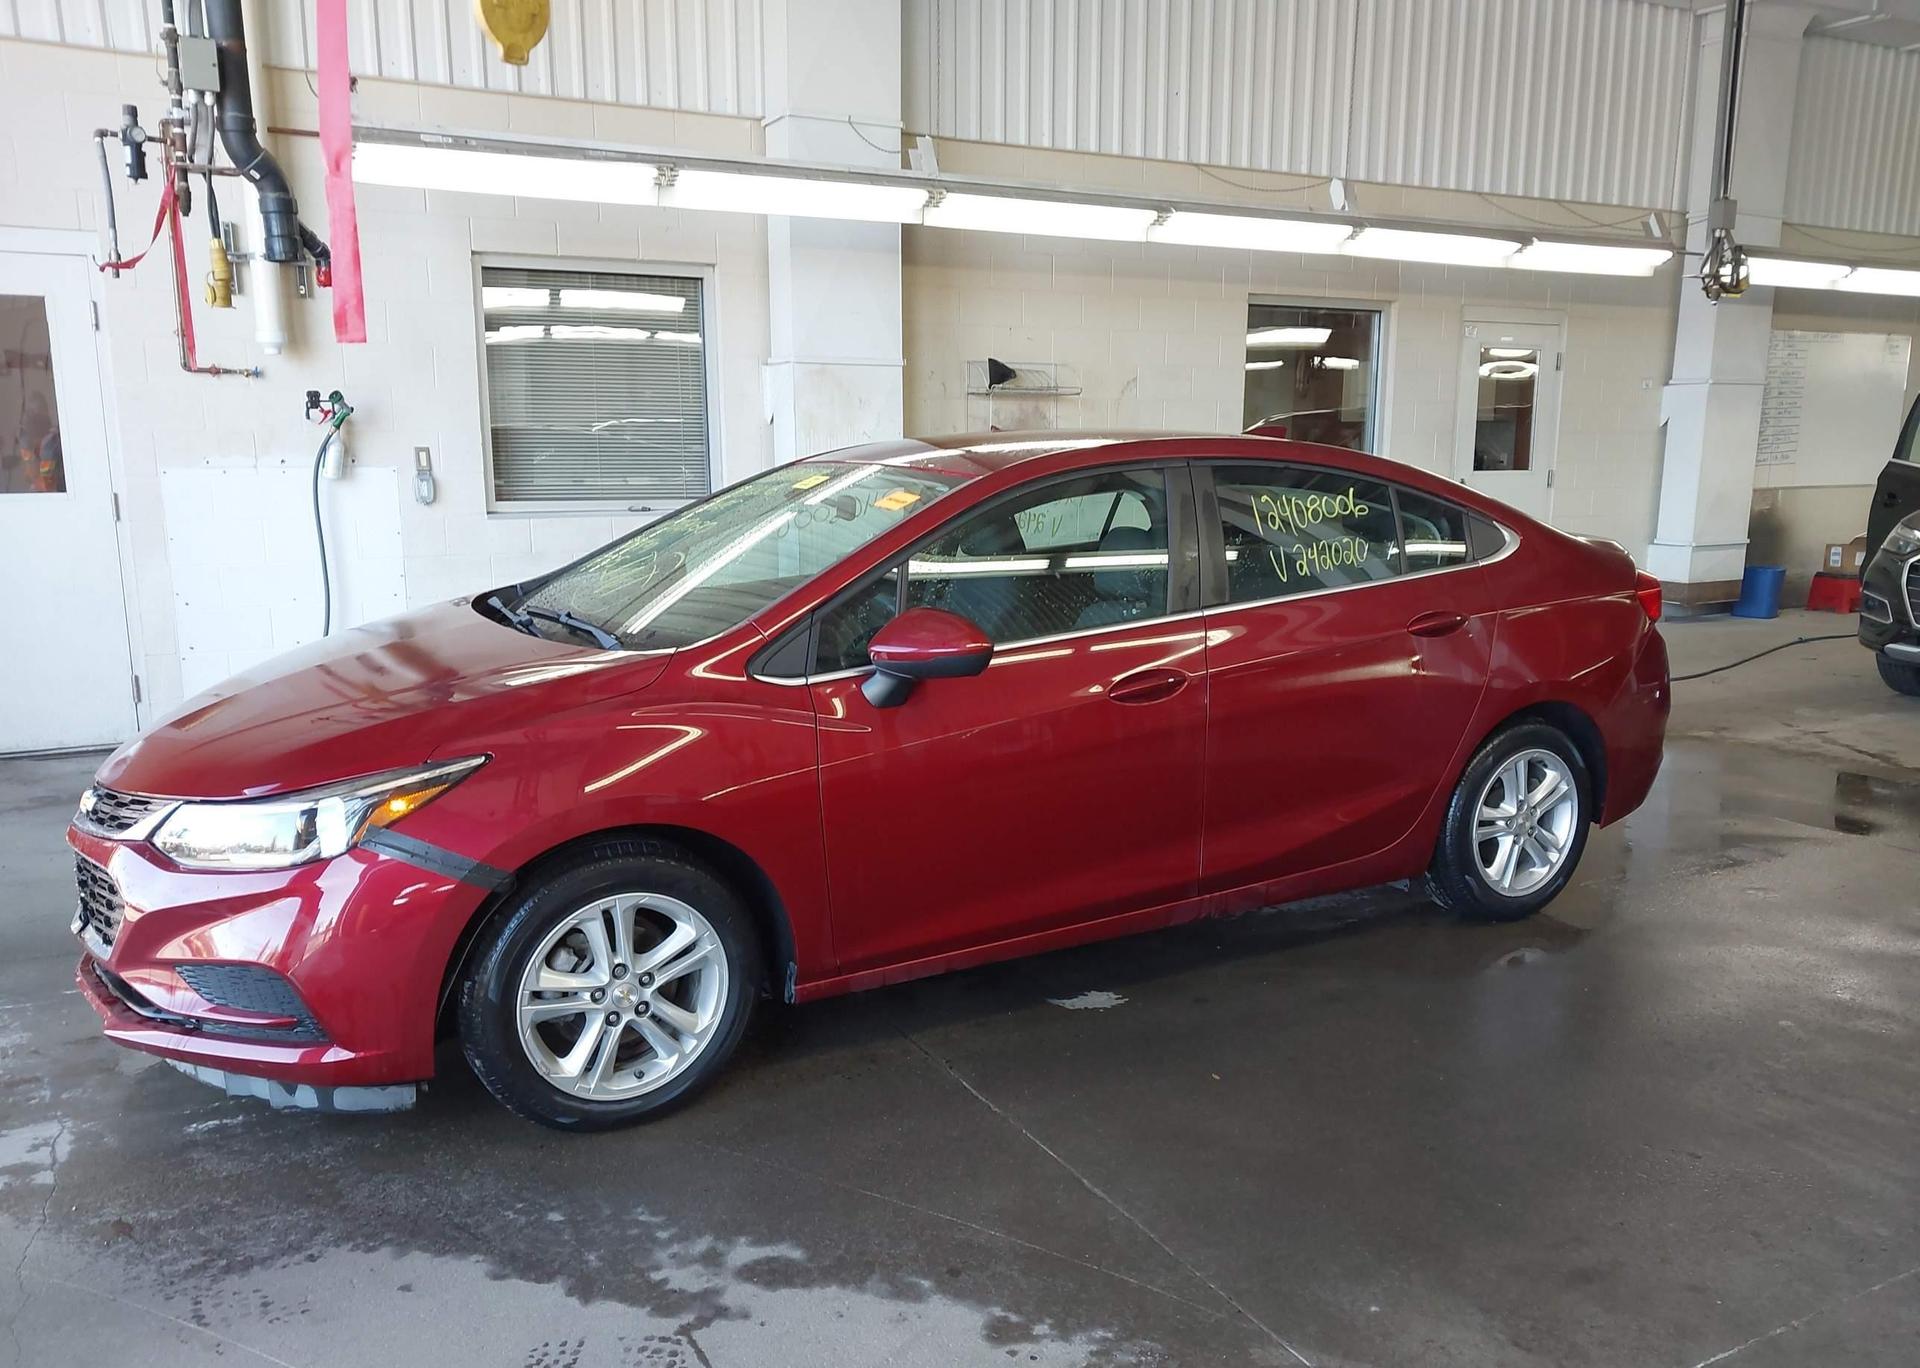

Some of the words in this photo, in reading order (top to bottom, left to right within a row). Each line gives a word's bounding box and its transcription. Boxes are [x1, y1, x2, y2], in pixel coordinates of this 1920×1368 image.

[1250, 487, 1369, 536] 12408006
[1269, 546, 1288, 582] V
[1292, 537, 1369, 576] 242020
